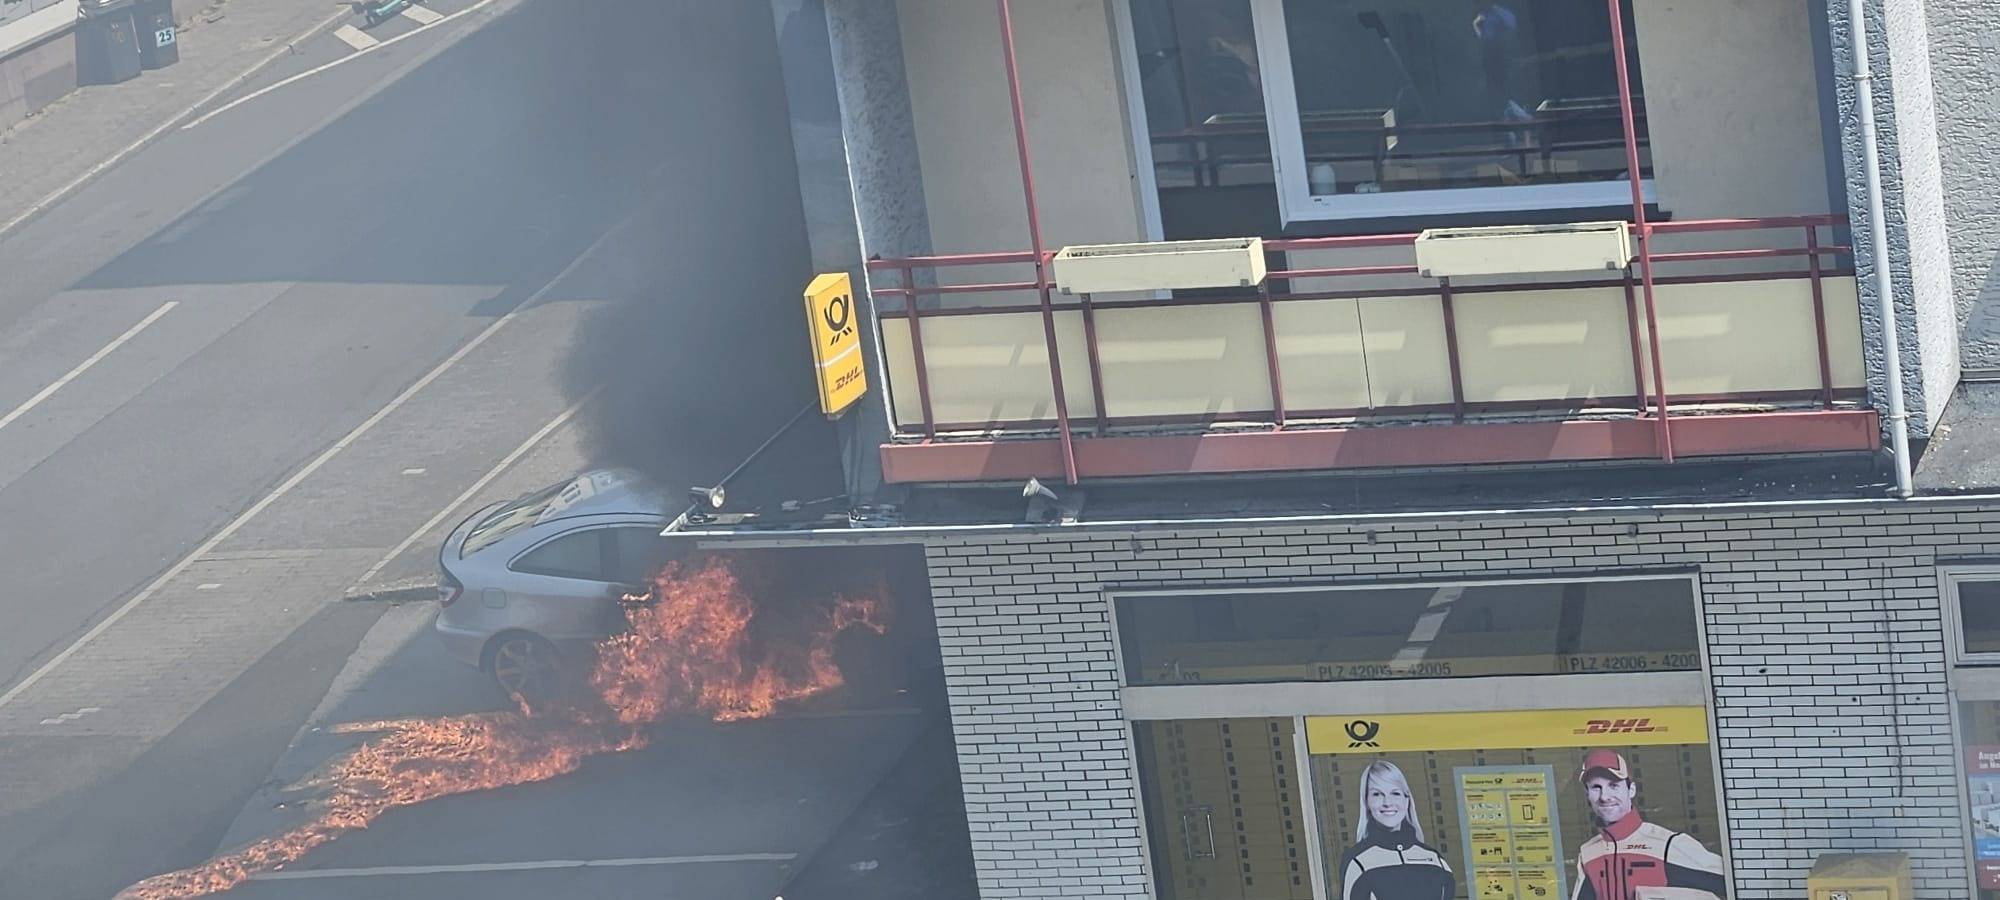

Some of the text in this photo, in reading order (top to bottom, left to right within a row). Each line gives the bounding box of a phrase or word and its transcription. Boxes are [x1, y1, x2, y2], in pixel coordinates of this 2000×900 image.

[159, 30, 172, 43] 25
[835, 366, 861, 391] DHL
[1319, 666, 1345, 680] PLZ
[1407, 662, 1451, 676] 42005
[1571, 657, 1598, 671] PLZ
[1602, 655, 1647, 670] 42006
[1586, 718, 1656, 734] DHL
